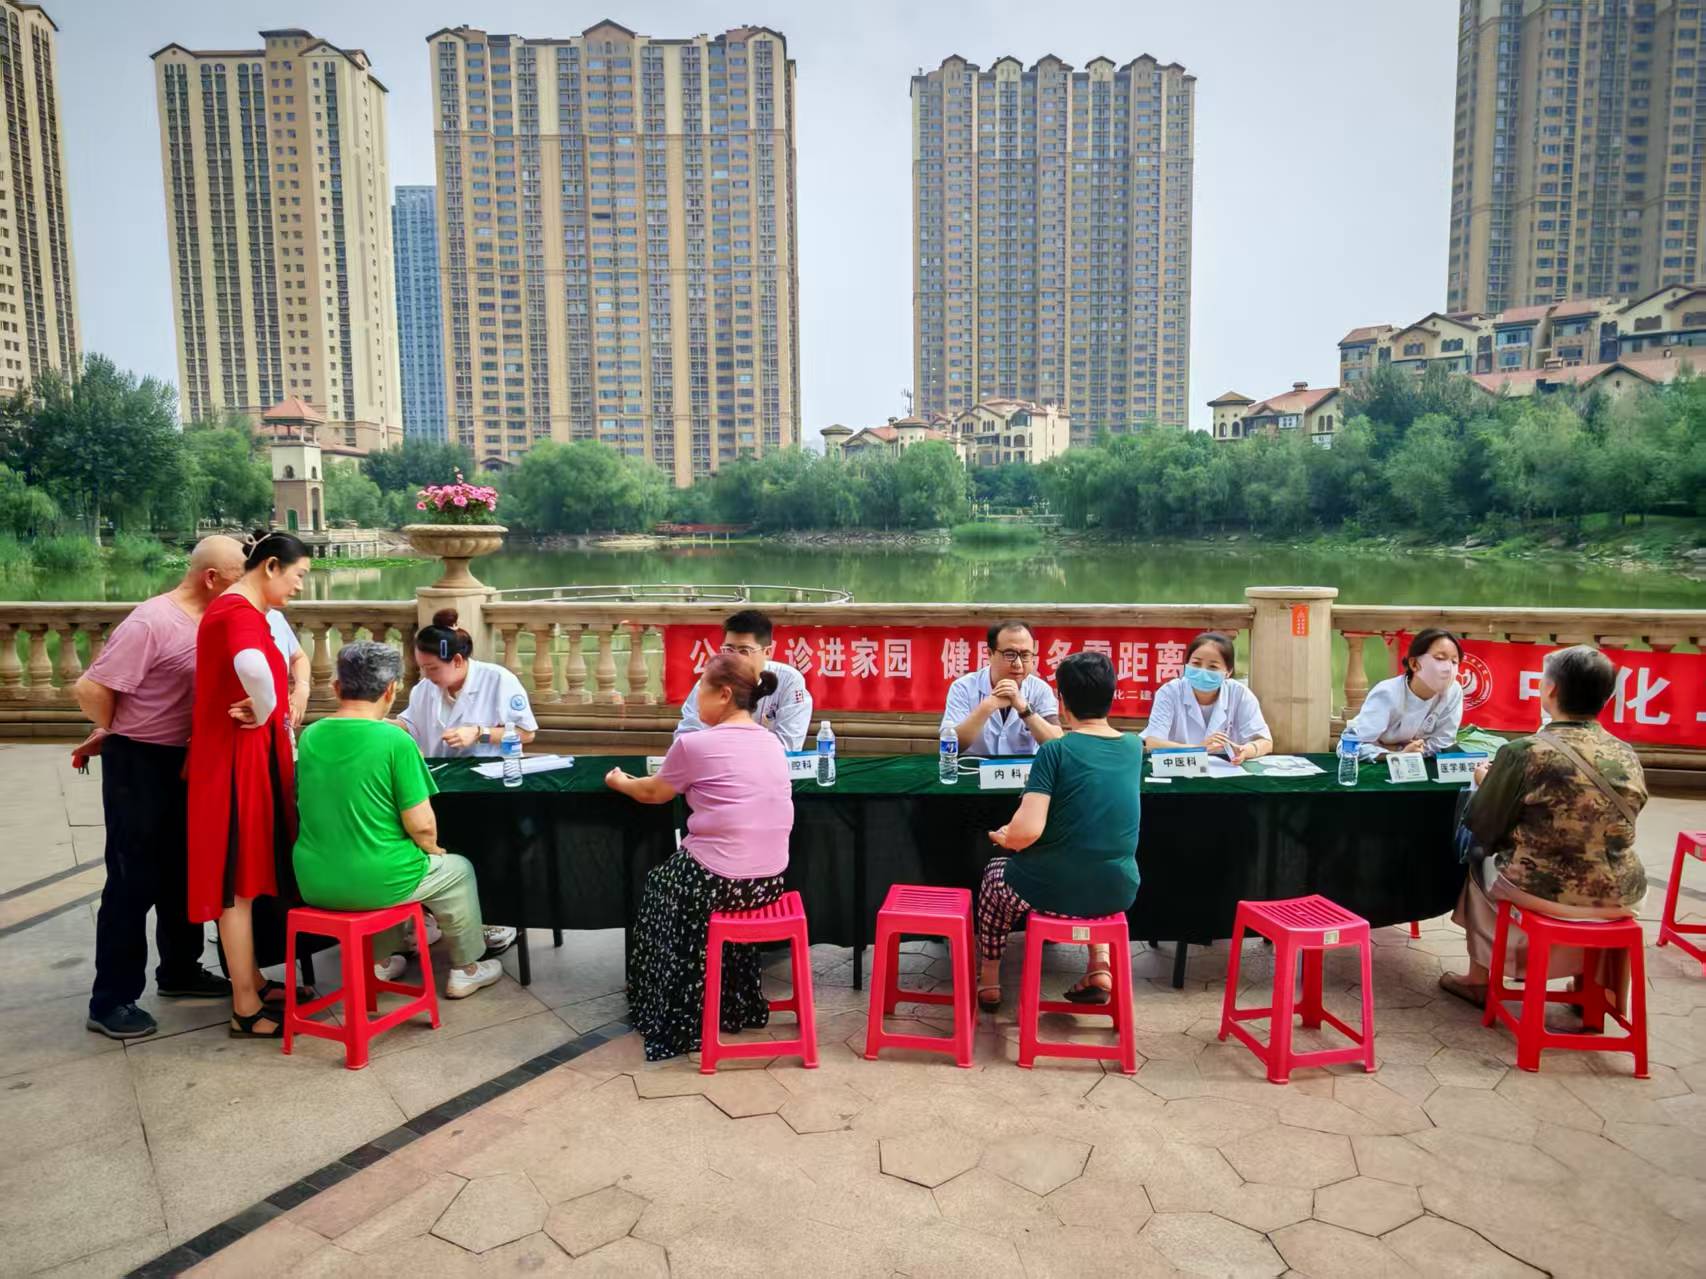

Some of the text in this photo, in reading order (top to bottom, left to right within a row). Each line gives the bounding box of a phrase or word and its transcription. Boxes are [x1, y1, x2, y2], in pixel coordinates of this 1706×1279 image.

[689, 637, 912, 679] 公诊进家园
[1163, 755, 1197, 768] 中医科
[993, 768, 1021, 780] 内科
